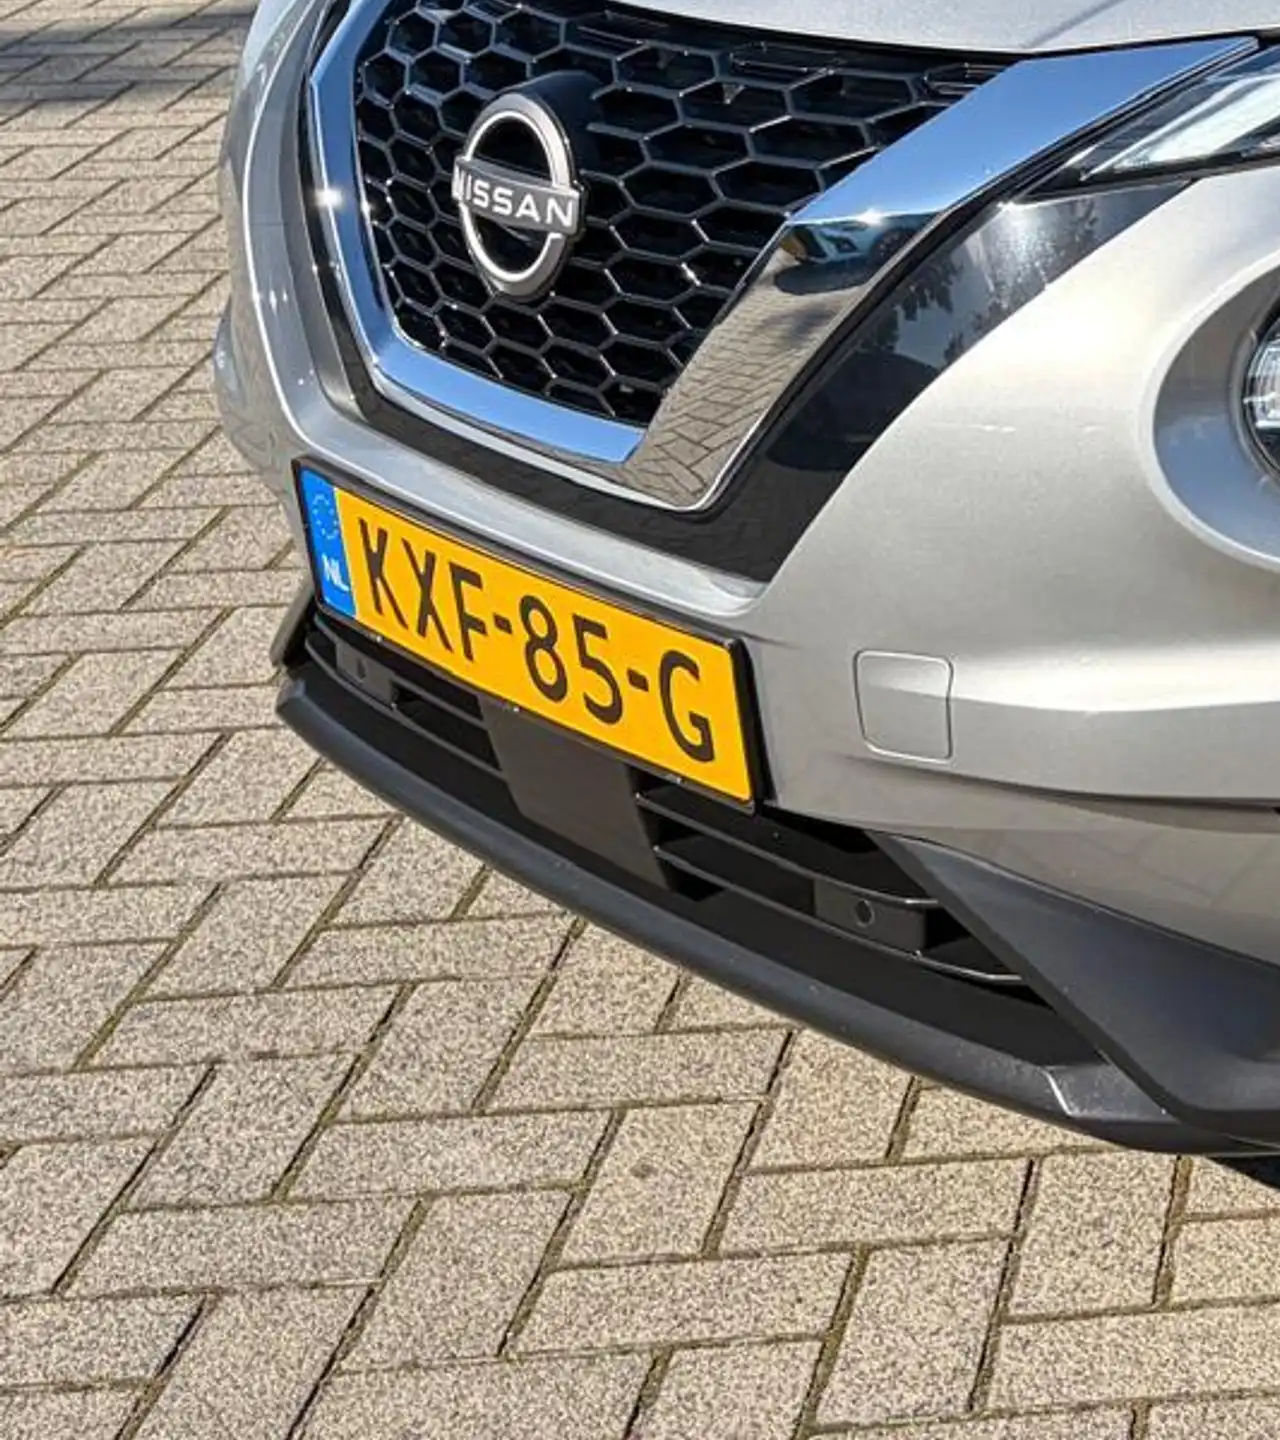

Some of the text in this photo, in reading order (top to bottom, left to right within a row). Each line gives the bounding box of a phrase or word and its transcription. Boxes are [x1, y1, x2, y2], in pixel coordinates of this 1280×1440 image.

[452, 162, 573, 227] NISSAN
[322, 553, 350, 593] NL
[358, 516, 715, 763] KXF-85-G
